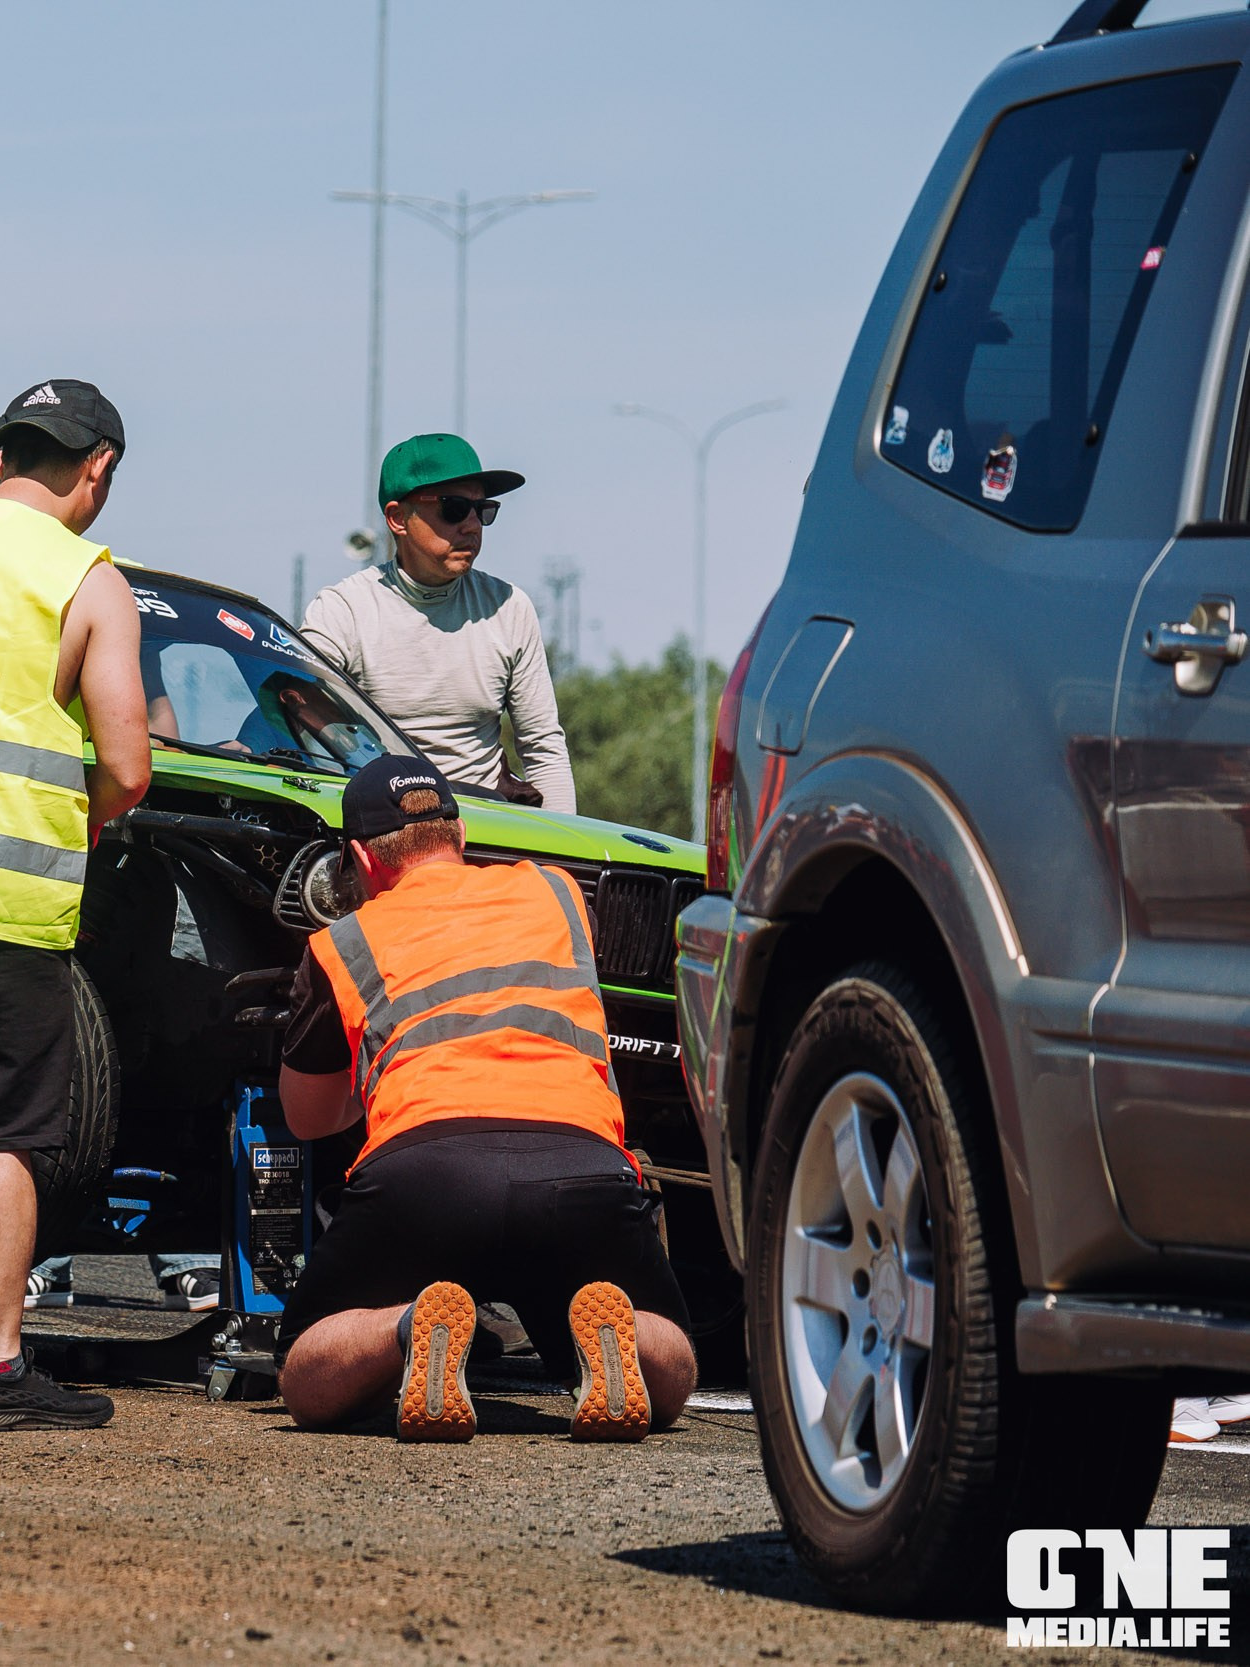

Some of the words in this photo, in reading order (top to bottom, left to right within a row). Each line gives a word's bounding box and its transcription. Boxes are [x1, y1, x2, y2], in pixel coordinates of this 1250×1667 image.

[22, 394, 61, 408] adidas
[608, 1034, 665, 1056] DRIFT
[257, 1149, 295, 1168] scheppach
